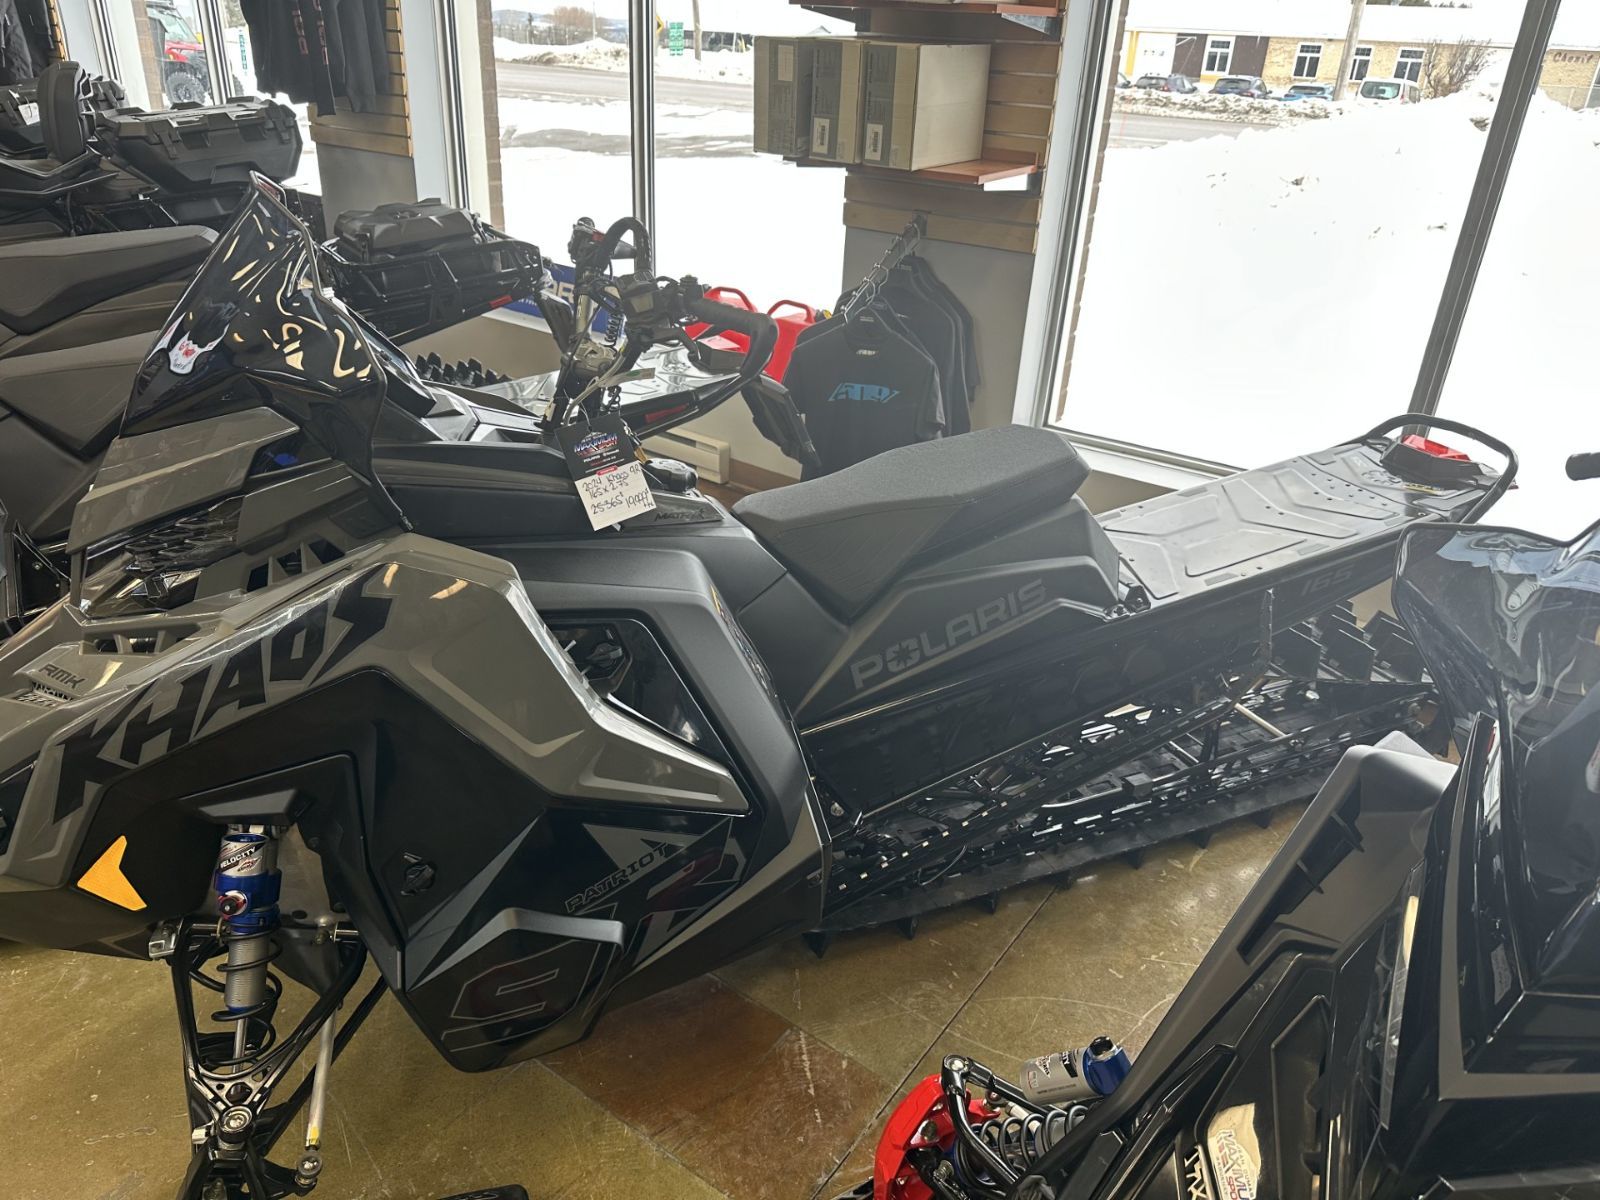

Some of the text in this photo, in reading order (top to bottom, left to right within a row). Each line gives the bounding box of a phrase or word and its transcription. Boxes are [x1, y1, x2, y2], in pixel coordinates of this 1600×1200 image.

[1301, 564, 1355, 596] 165
[849, 578, 1048, 690] POLARIS
[38, 663, 86, 689] RMK
[53, 563, 394, 824] KHAOS
[565, 842, 670, 913] PATRIOT
